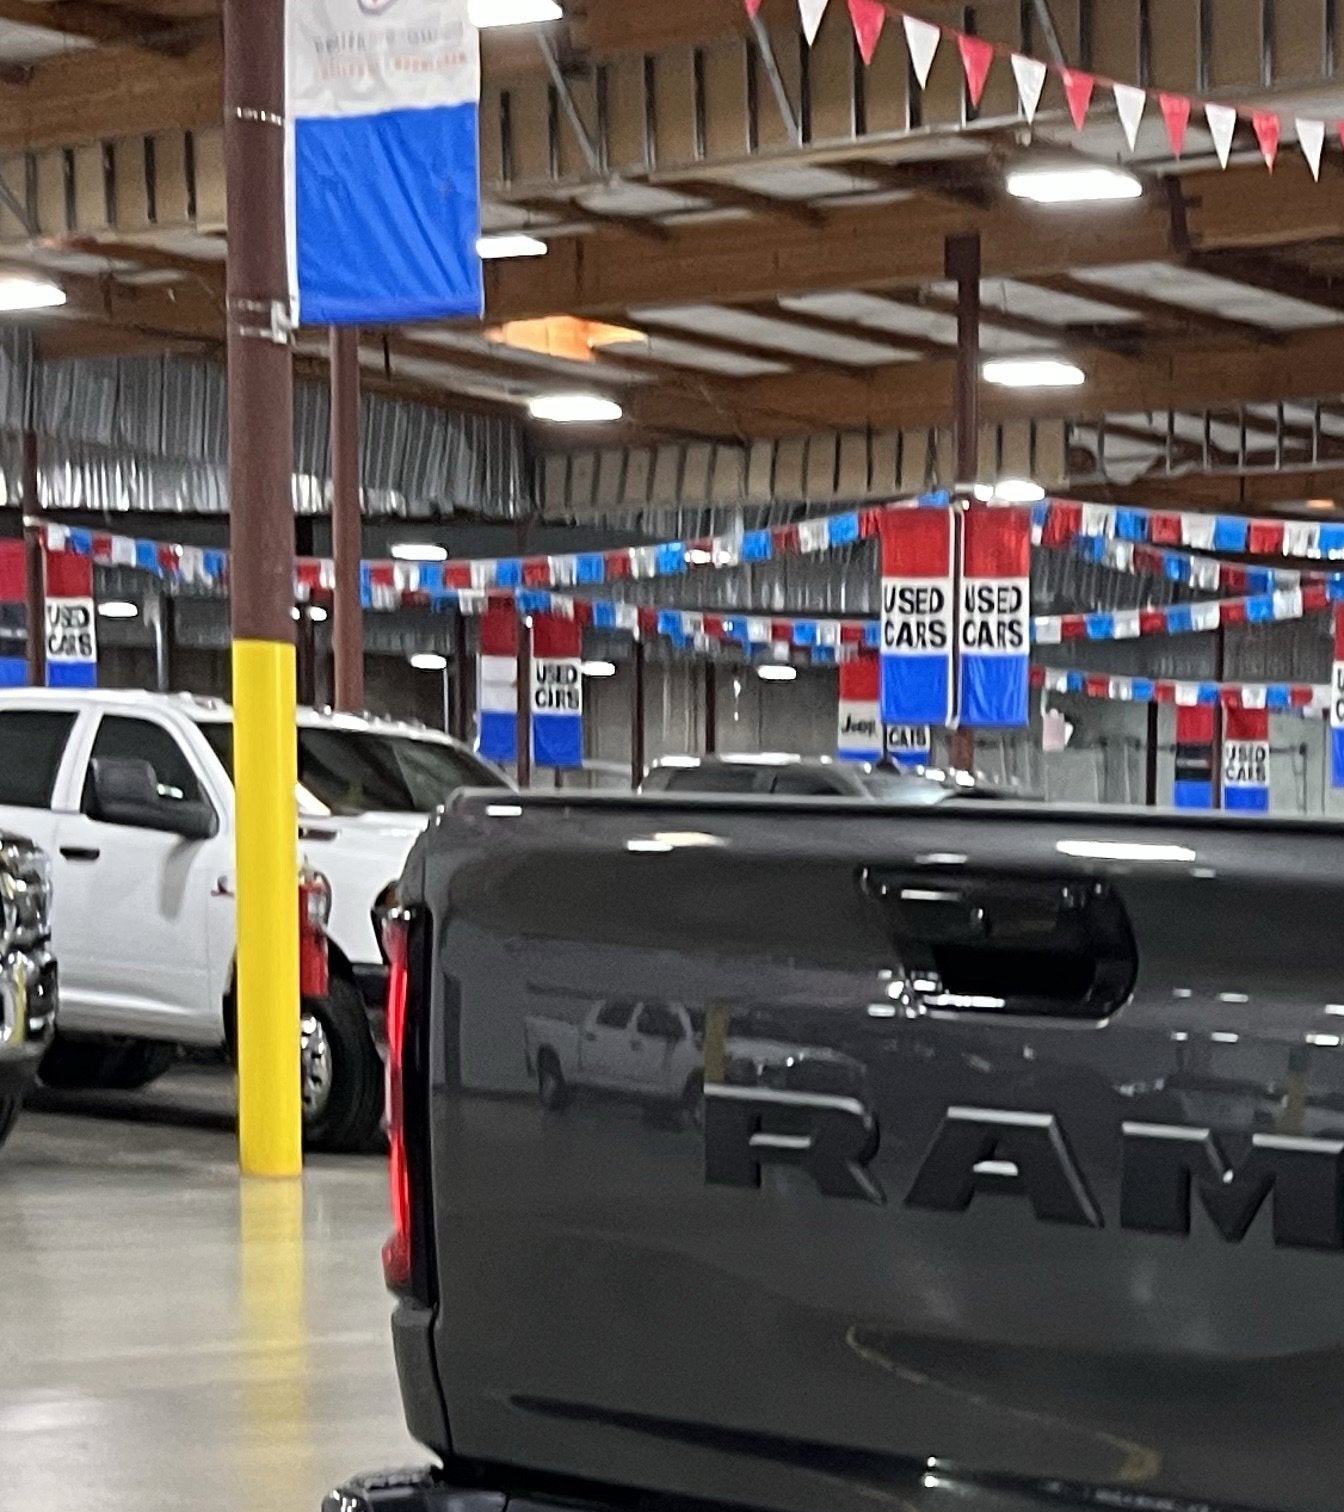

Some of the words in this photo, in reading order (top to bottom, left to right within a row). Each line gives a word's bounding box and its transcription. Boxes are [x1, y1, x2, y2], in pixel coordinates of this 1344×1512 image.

[883, 585, 945, 615] USED
[965, 584, 1023, 614] USED
[883, 617, 947, 648] CARS
[962, 618, 1024, 648] CARS
[536, 663, 578, 684] USED
[535, 686, 580, 710] CARS
